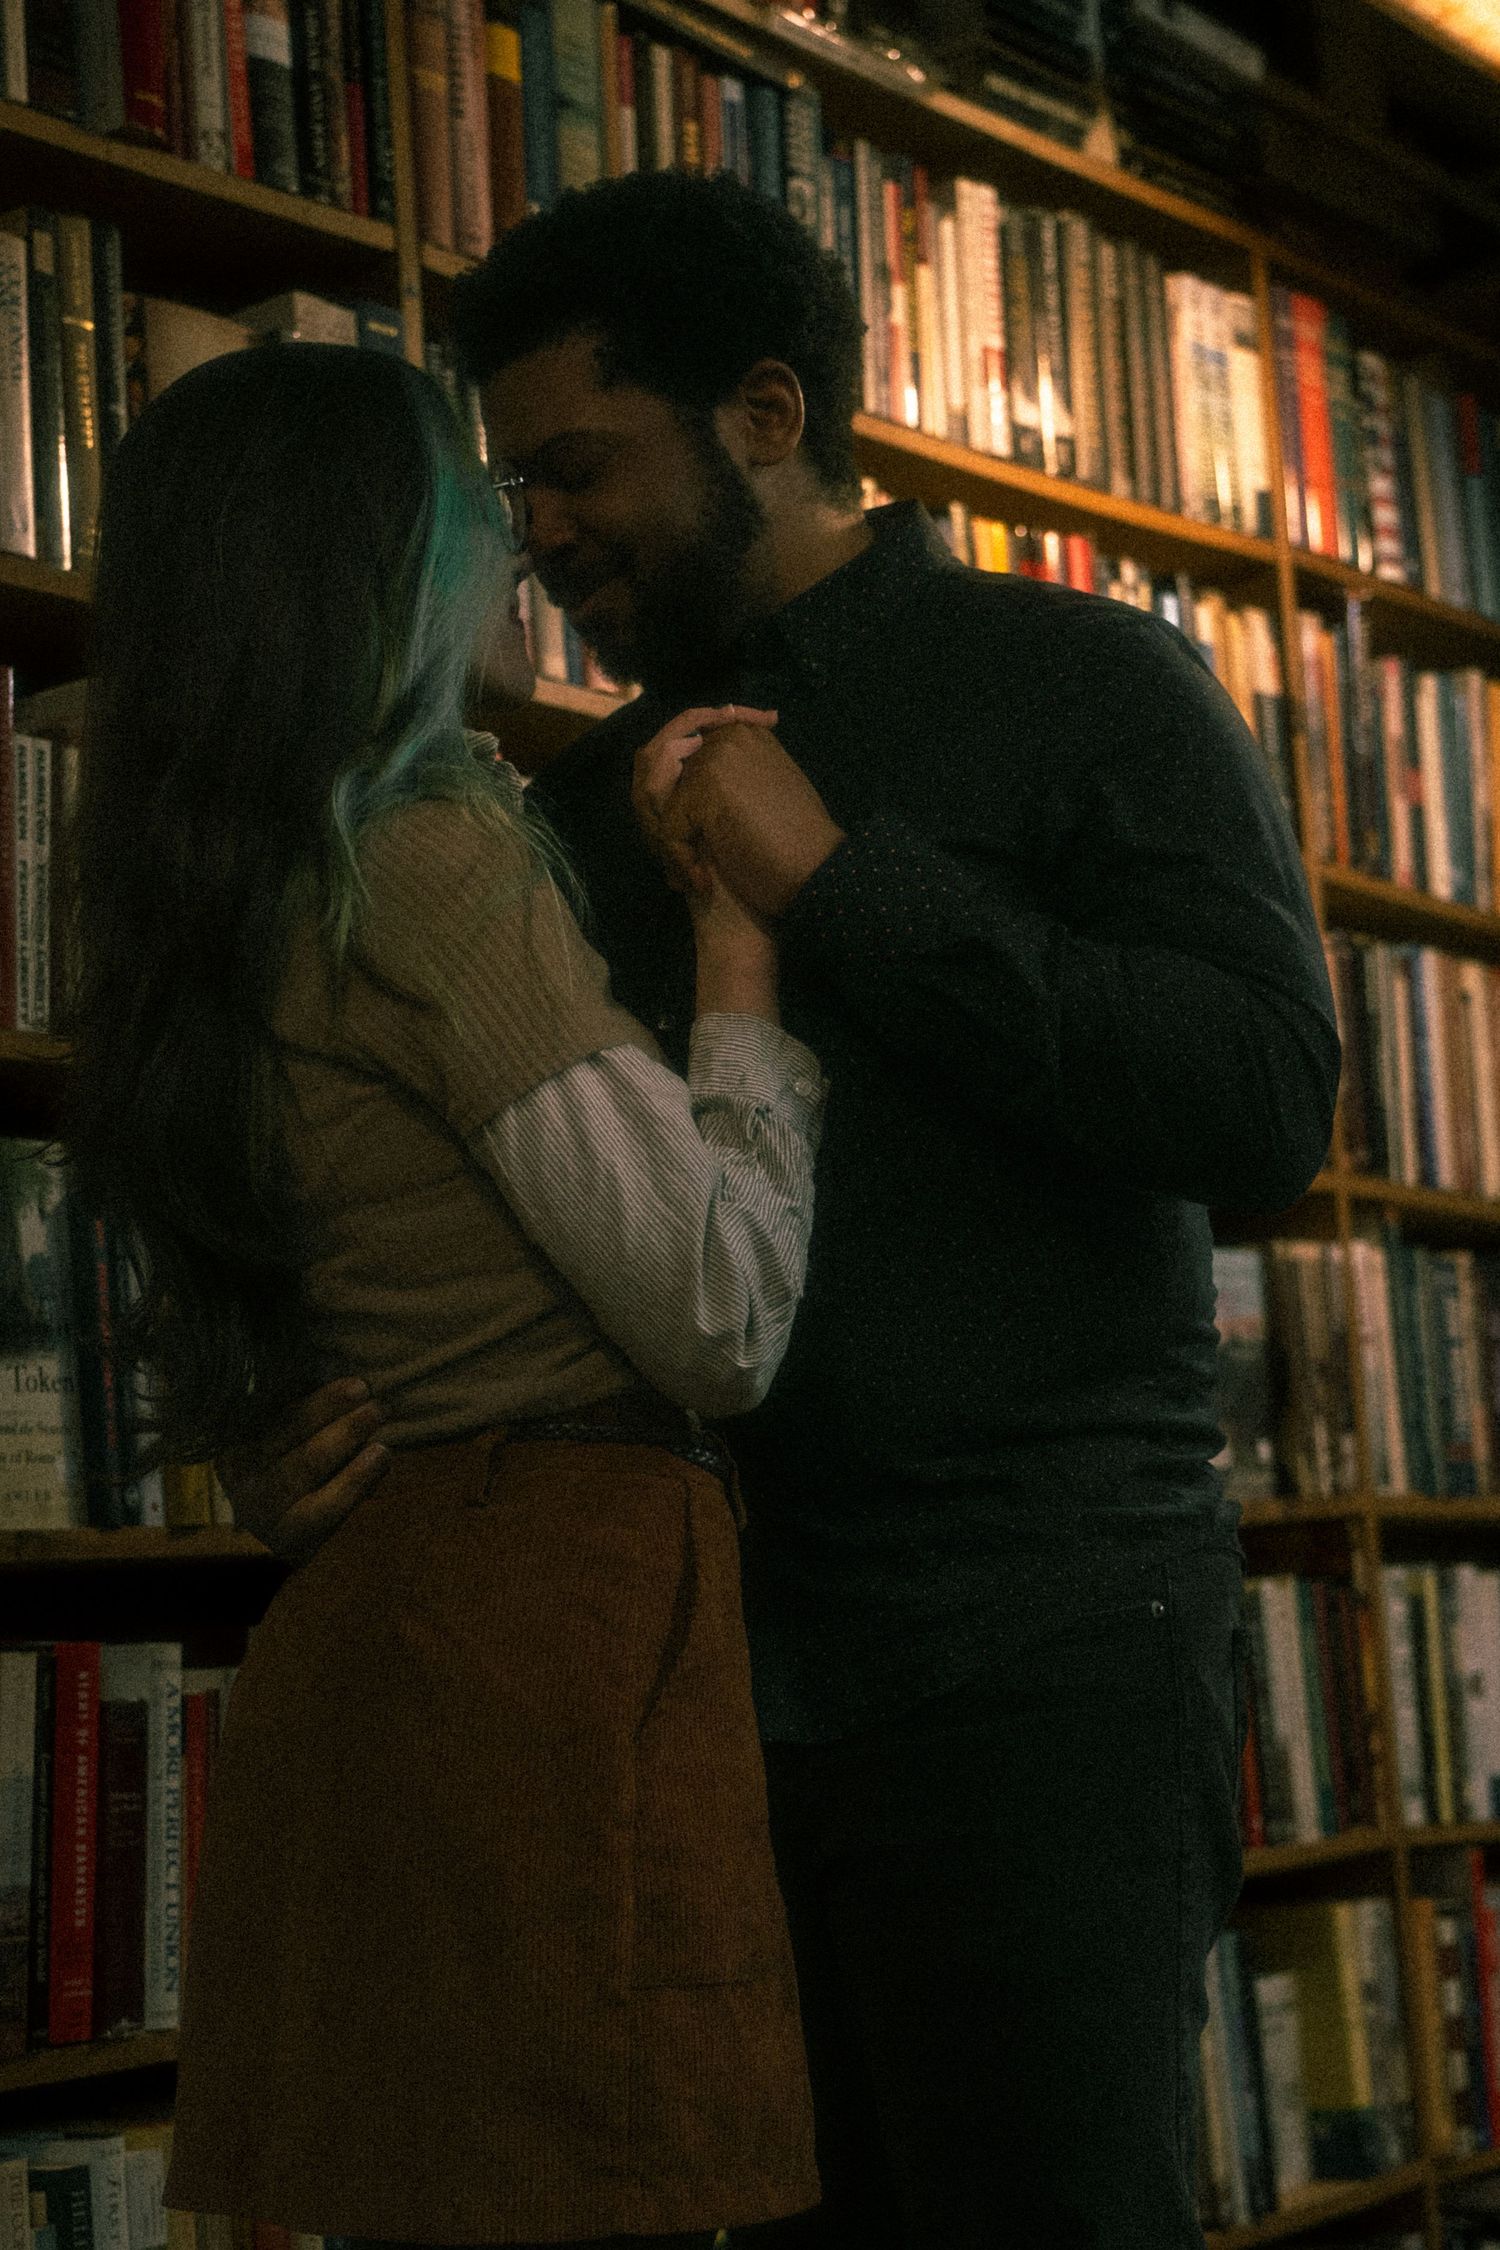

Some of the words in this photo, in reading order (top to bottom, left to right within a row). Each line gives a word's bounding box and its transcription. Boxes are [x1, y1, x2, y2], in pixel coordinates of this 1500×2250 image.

[166, 1681, 179, 1698] A
[166, 1705, 180, 1776] MORE
[75, 1754, 89, 1837] AMERICAN
[165, 1787, 180, 1891] PERFECT
[165, 1902, 180, 1993] UNION
